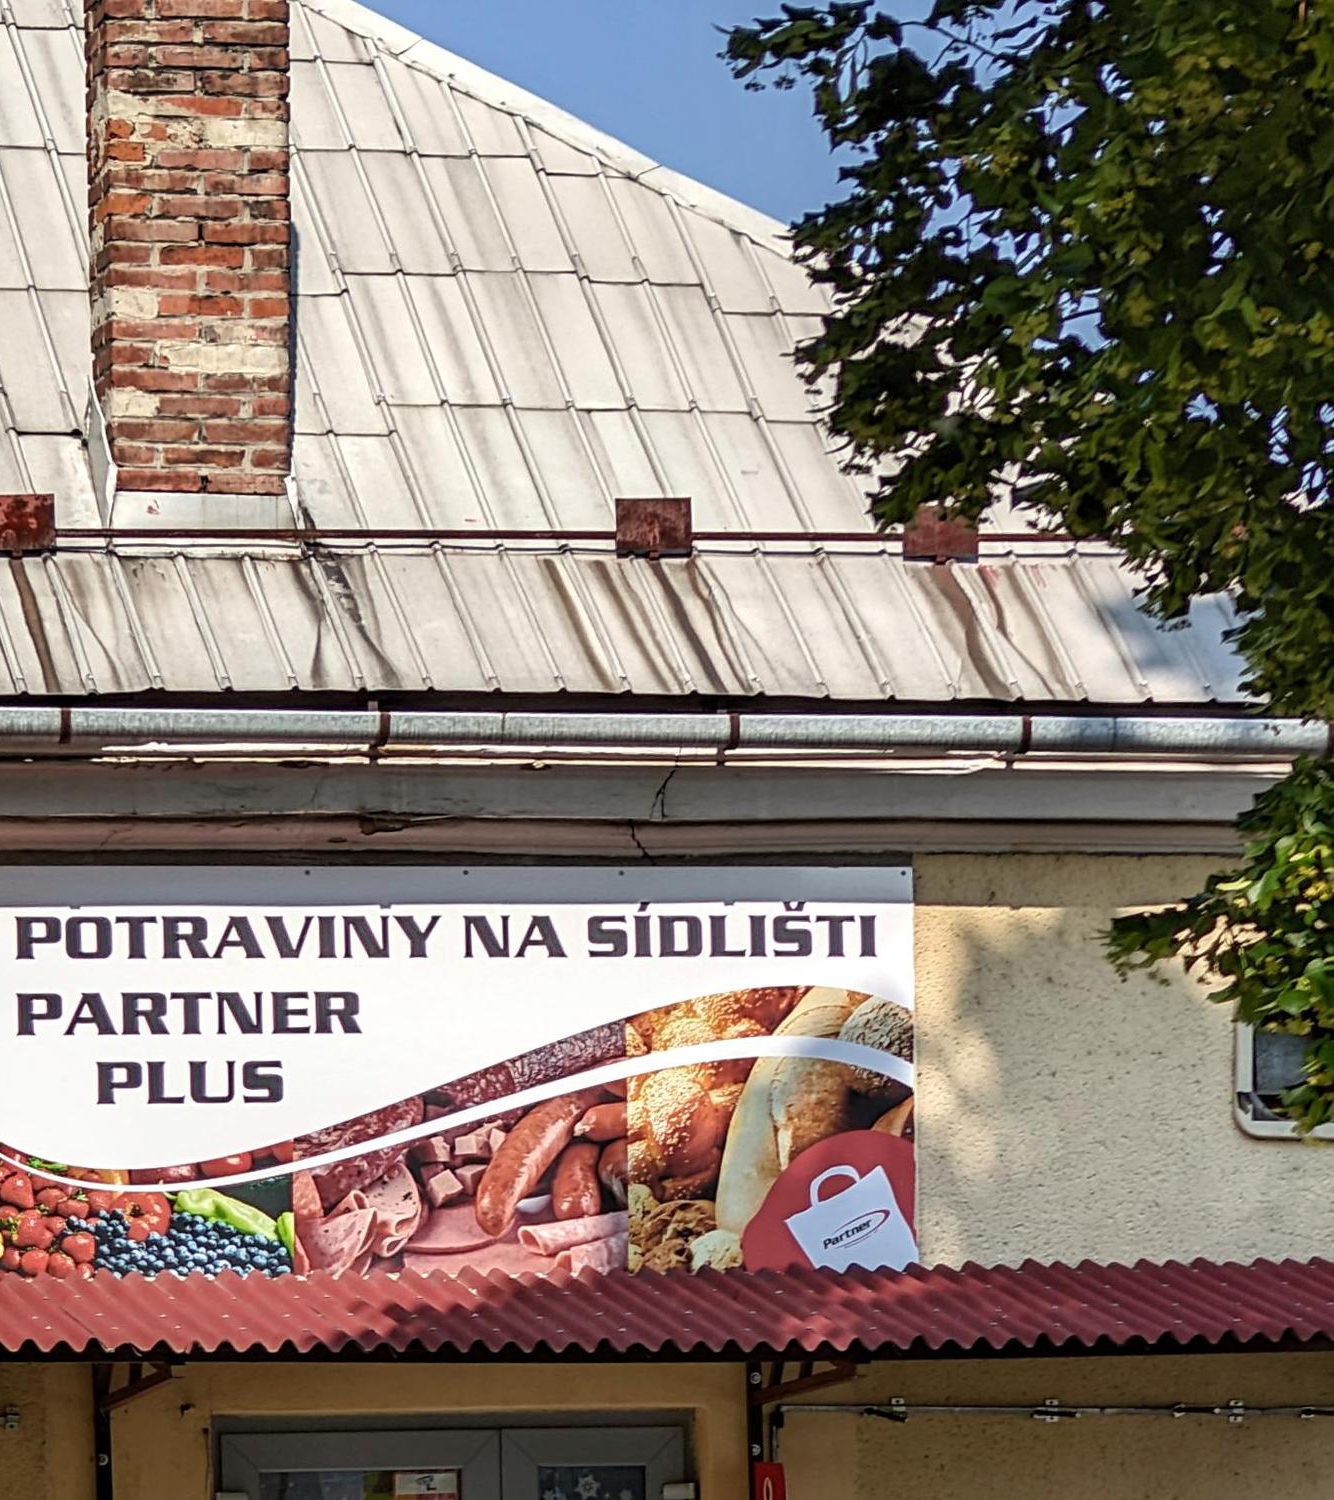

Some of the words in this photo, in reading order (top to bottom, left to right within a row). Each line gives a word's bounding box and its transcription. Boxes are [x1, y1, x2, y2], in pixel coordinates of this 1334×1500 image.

[15, 915, 442, 961] POTRAVINY
[463, 914, 568, 958] NA
[588, 900, 878, 958] SÍDLIŠTI
[16, 991, 363, 1036] PARTNER
[96, 1060, 285, 1105] PLUS
[823, 1219, 872, 1250] Partner
